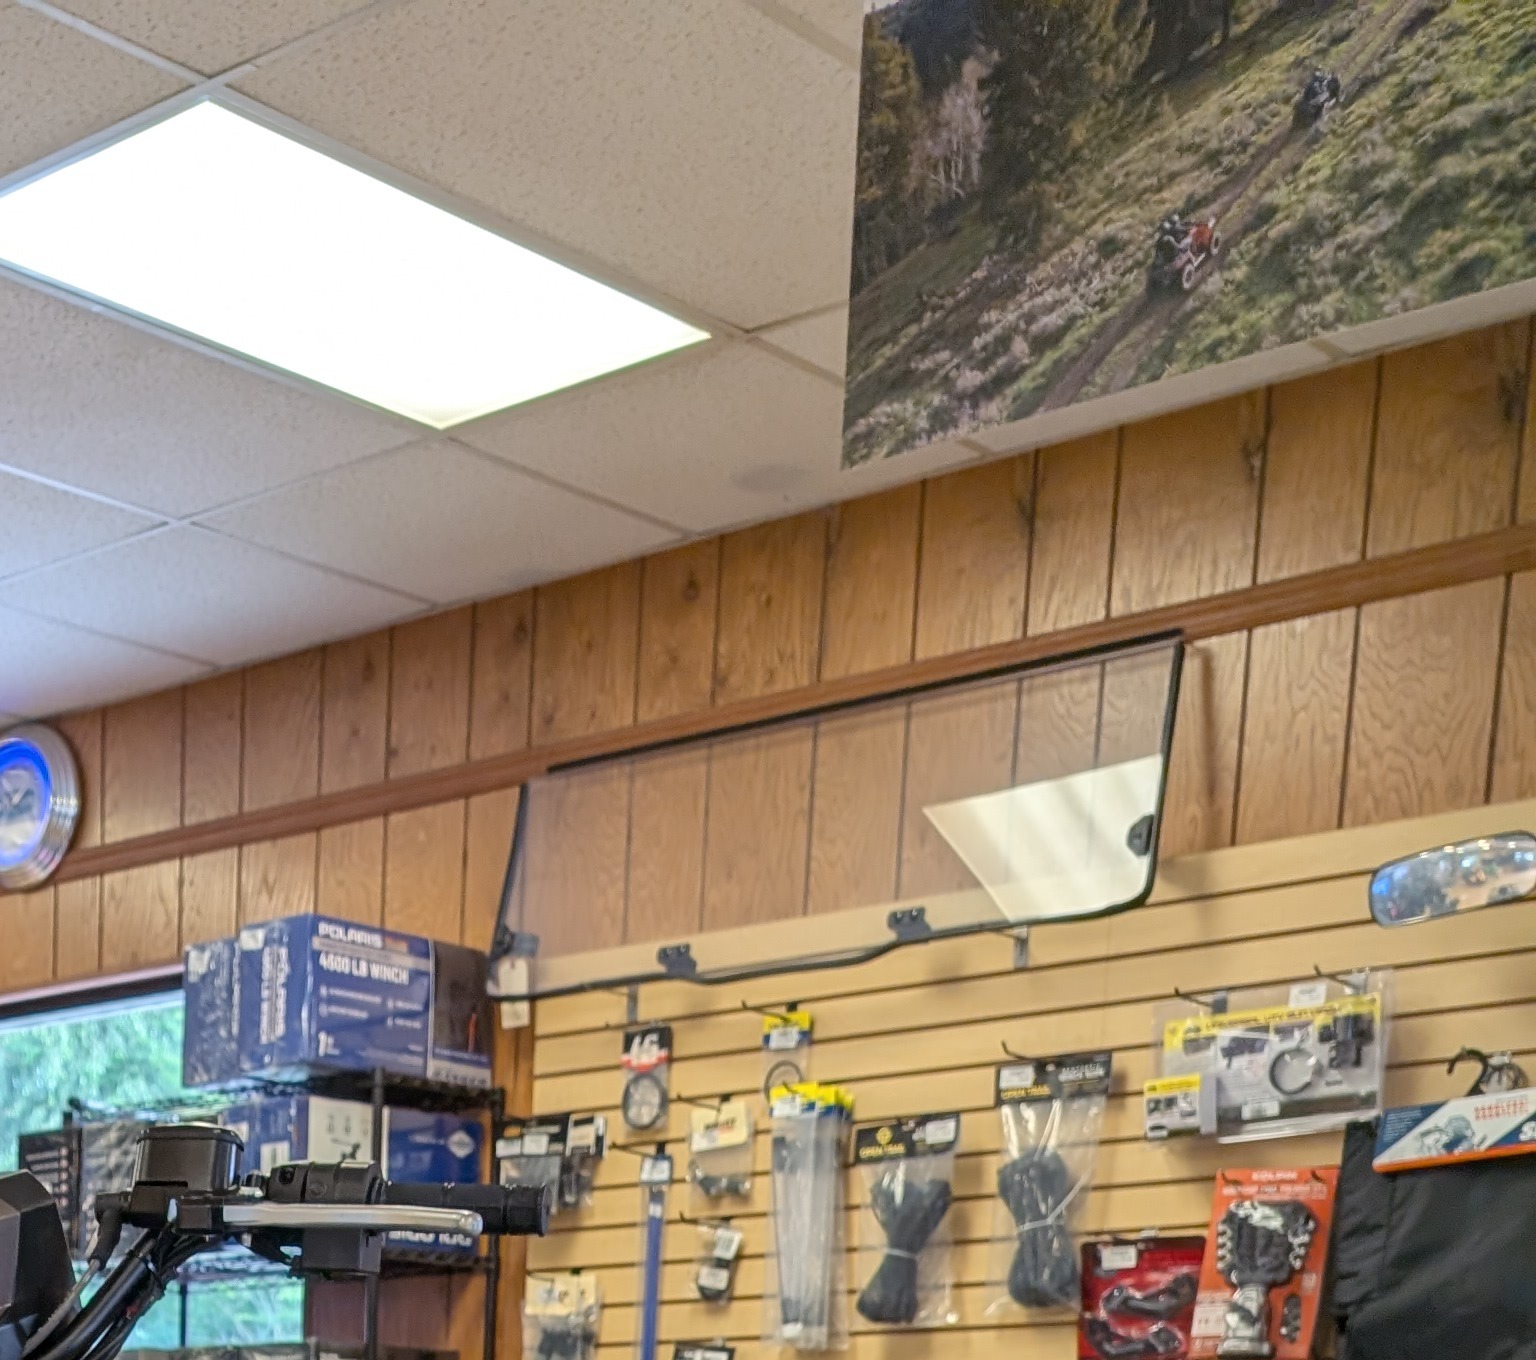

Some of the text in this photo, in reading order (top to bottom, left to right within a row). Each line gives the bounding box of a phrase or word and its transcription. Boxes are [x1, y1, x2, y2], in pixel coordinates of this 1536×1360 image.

[318, 921, 383, 949] POLARIS
[352, 957, 369, 978] LB
[370, 962, 409, 986] WINCH
